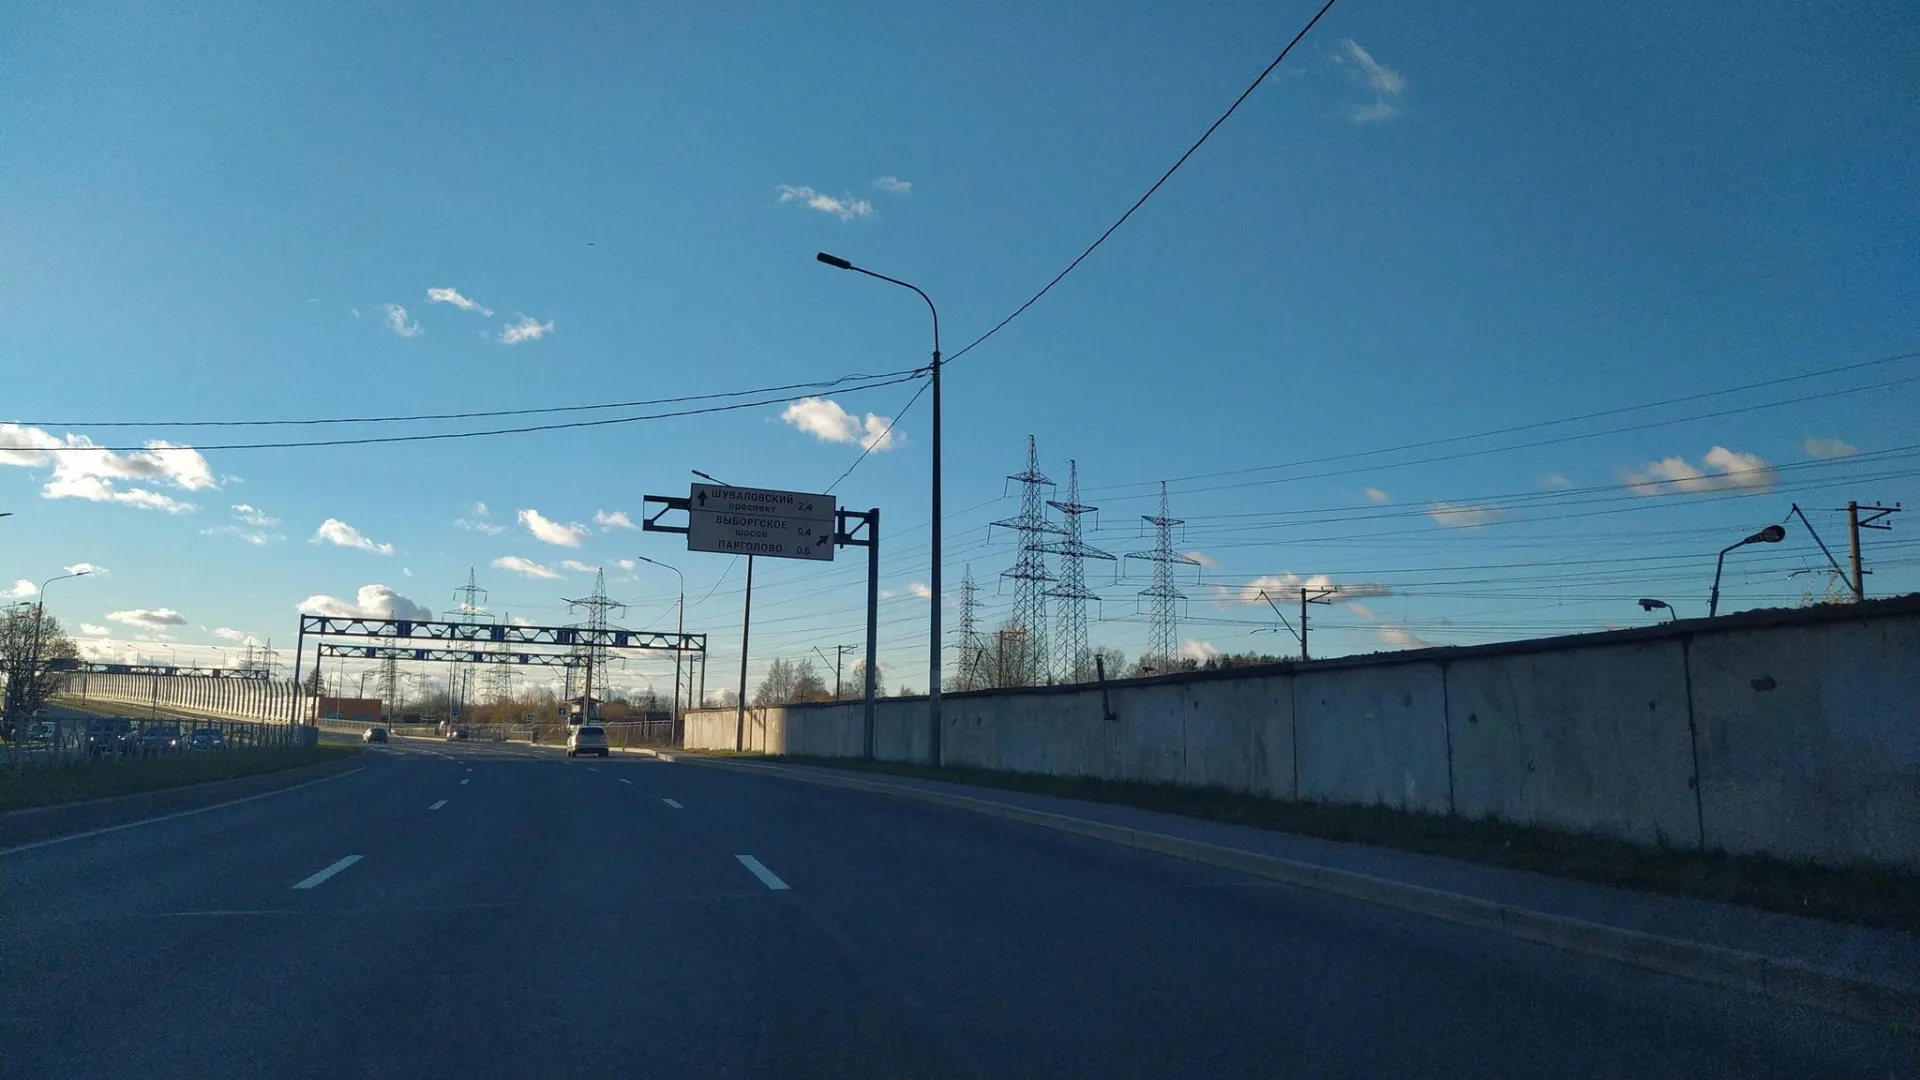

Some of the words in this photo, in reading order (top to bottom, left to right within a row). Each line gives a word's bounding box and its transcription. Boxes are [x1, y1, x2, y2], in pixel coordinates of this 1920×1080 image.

[711, 489, 794, 505] ШУВАЛОВСКИЙ
[728, 502, 777, 513] проспект
[716, 515, 787, 530] ВЫБОРГСКОЕ
[735, 529, 768, 538] шоссе
[718, 539, 783, 553] ПАРГОЛОВО
